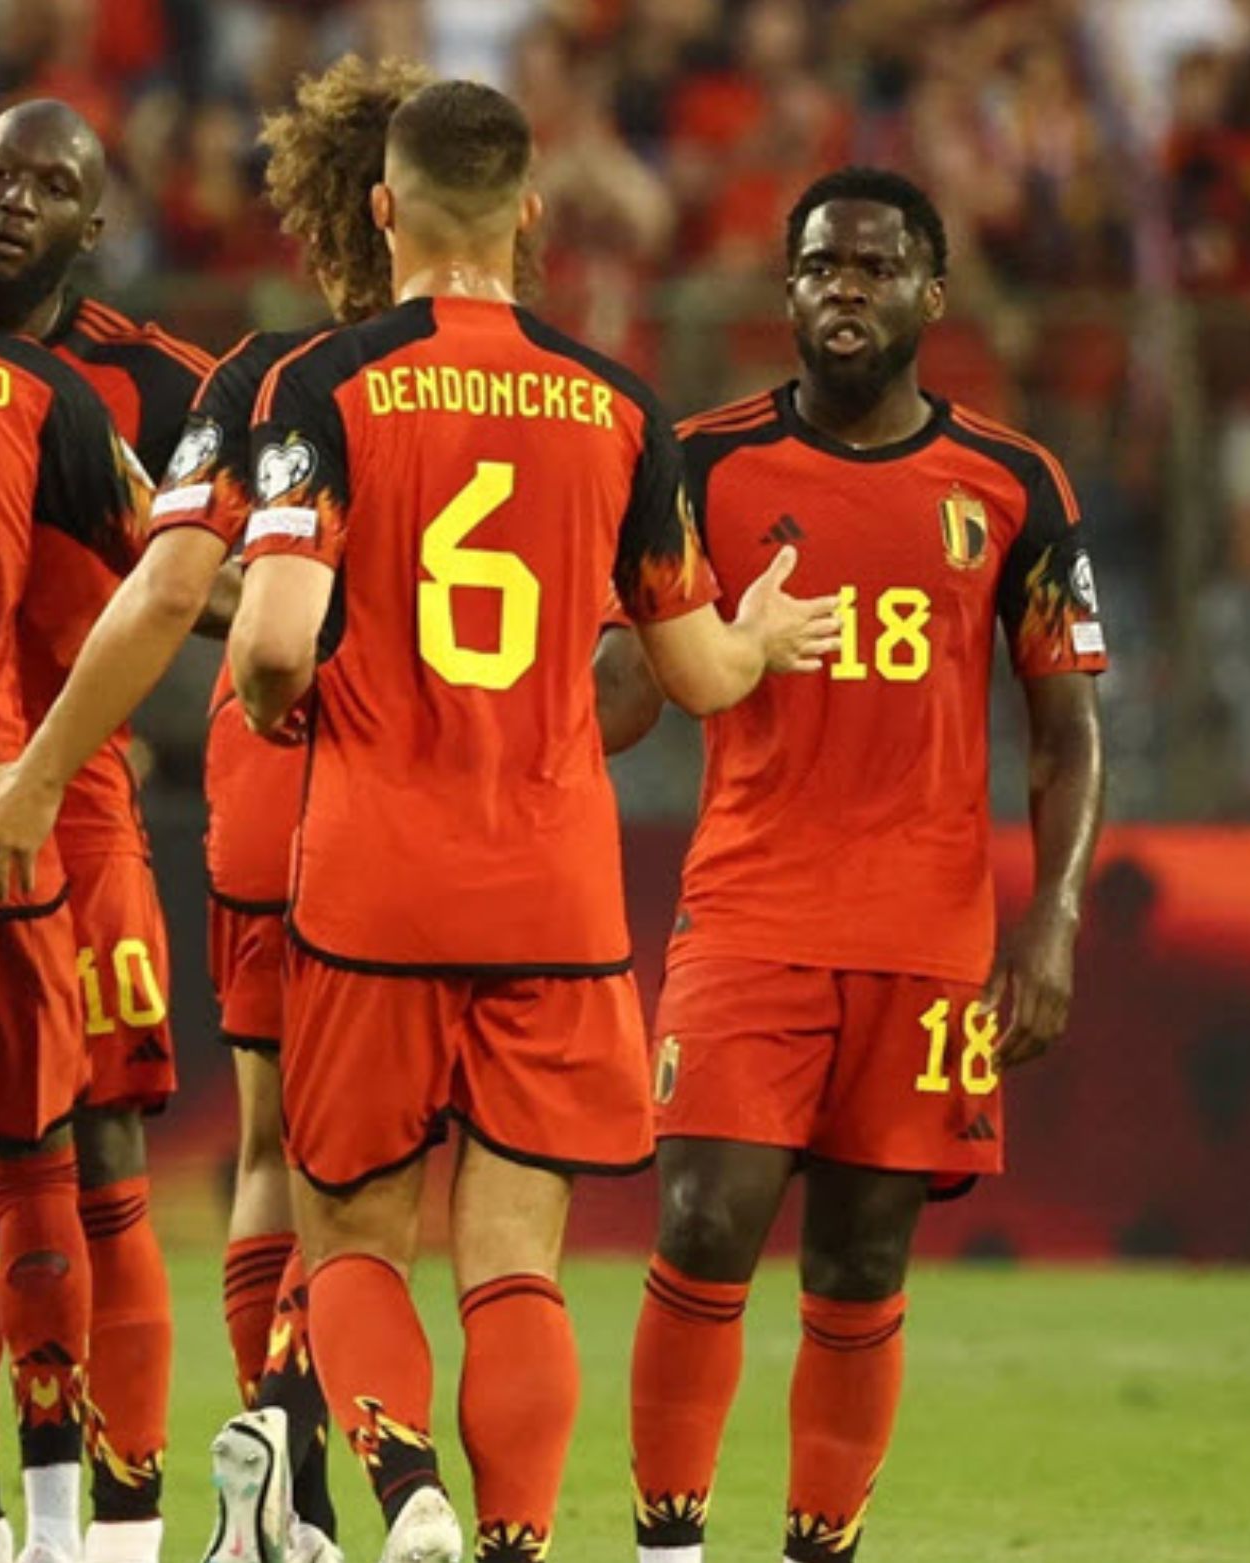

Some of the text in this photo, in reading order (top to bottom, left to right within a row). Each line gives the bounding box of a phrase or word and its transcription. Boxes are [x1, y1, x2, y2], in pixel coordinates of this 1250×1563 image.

[366, 366, 613, 429] DENDONCKER
[417, 461, 541, 690] 6
[830, 585, 932, 682] 18
[75, 937, 167, 1036] 10
[914, 998, 999, 1095] 18
